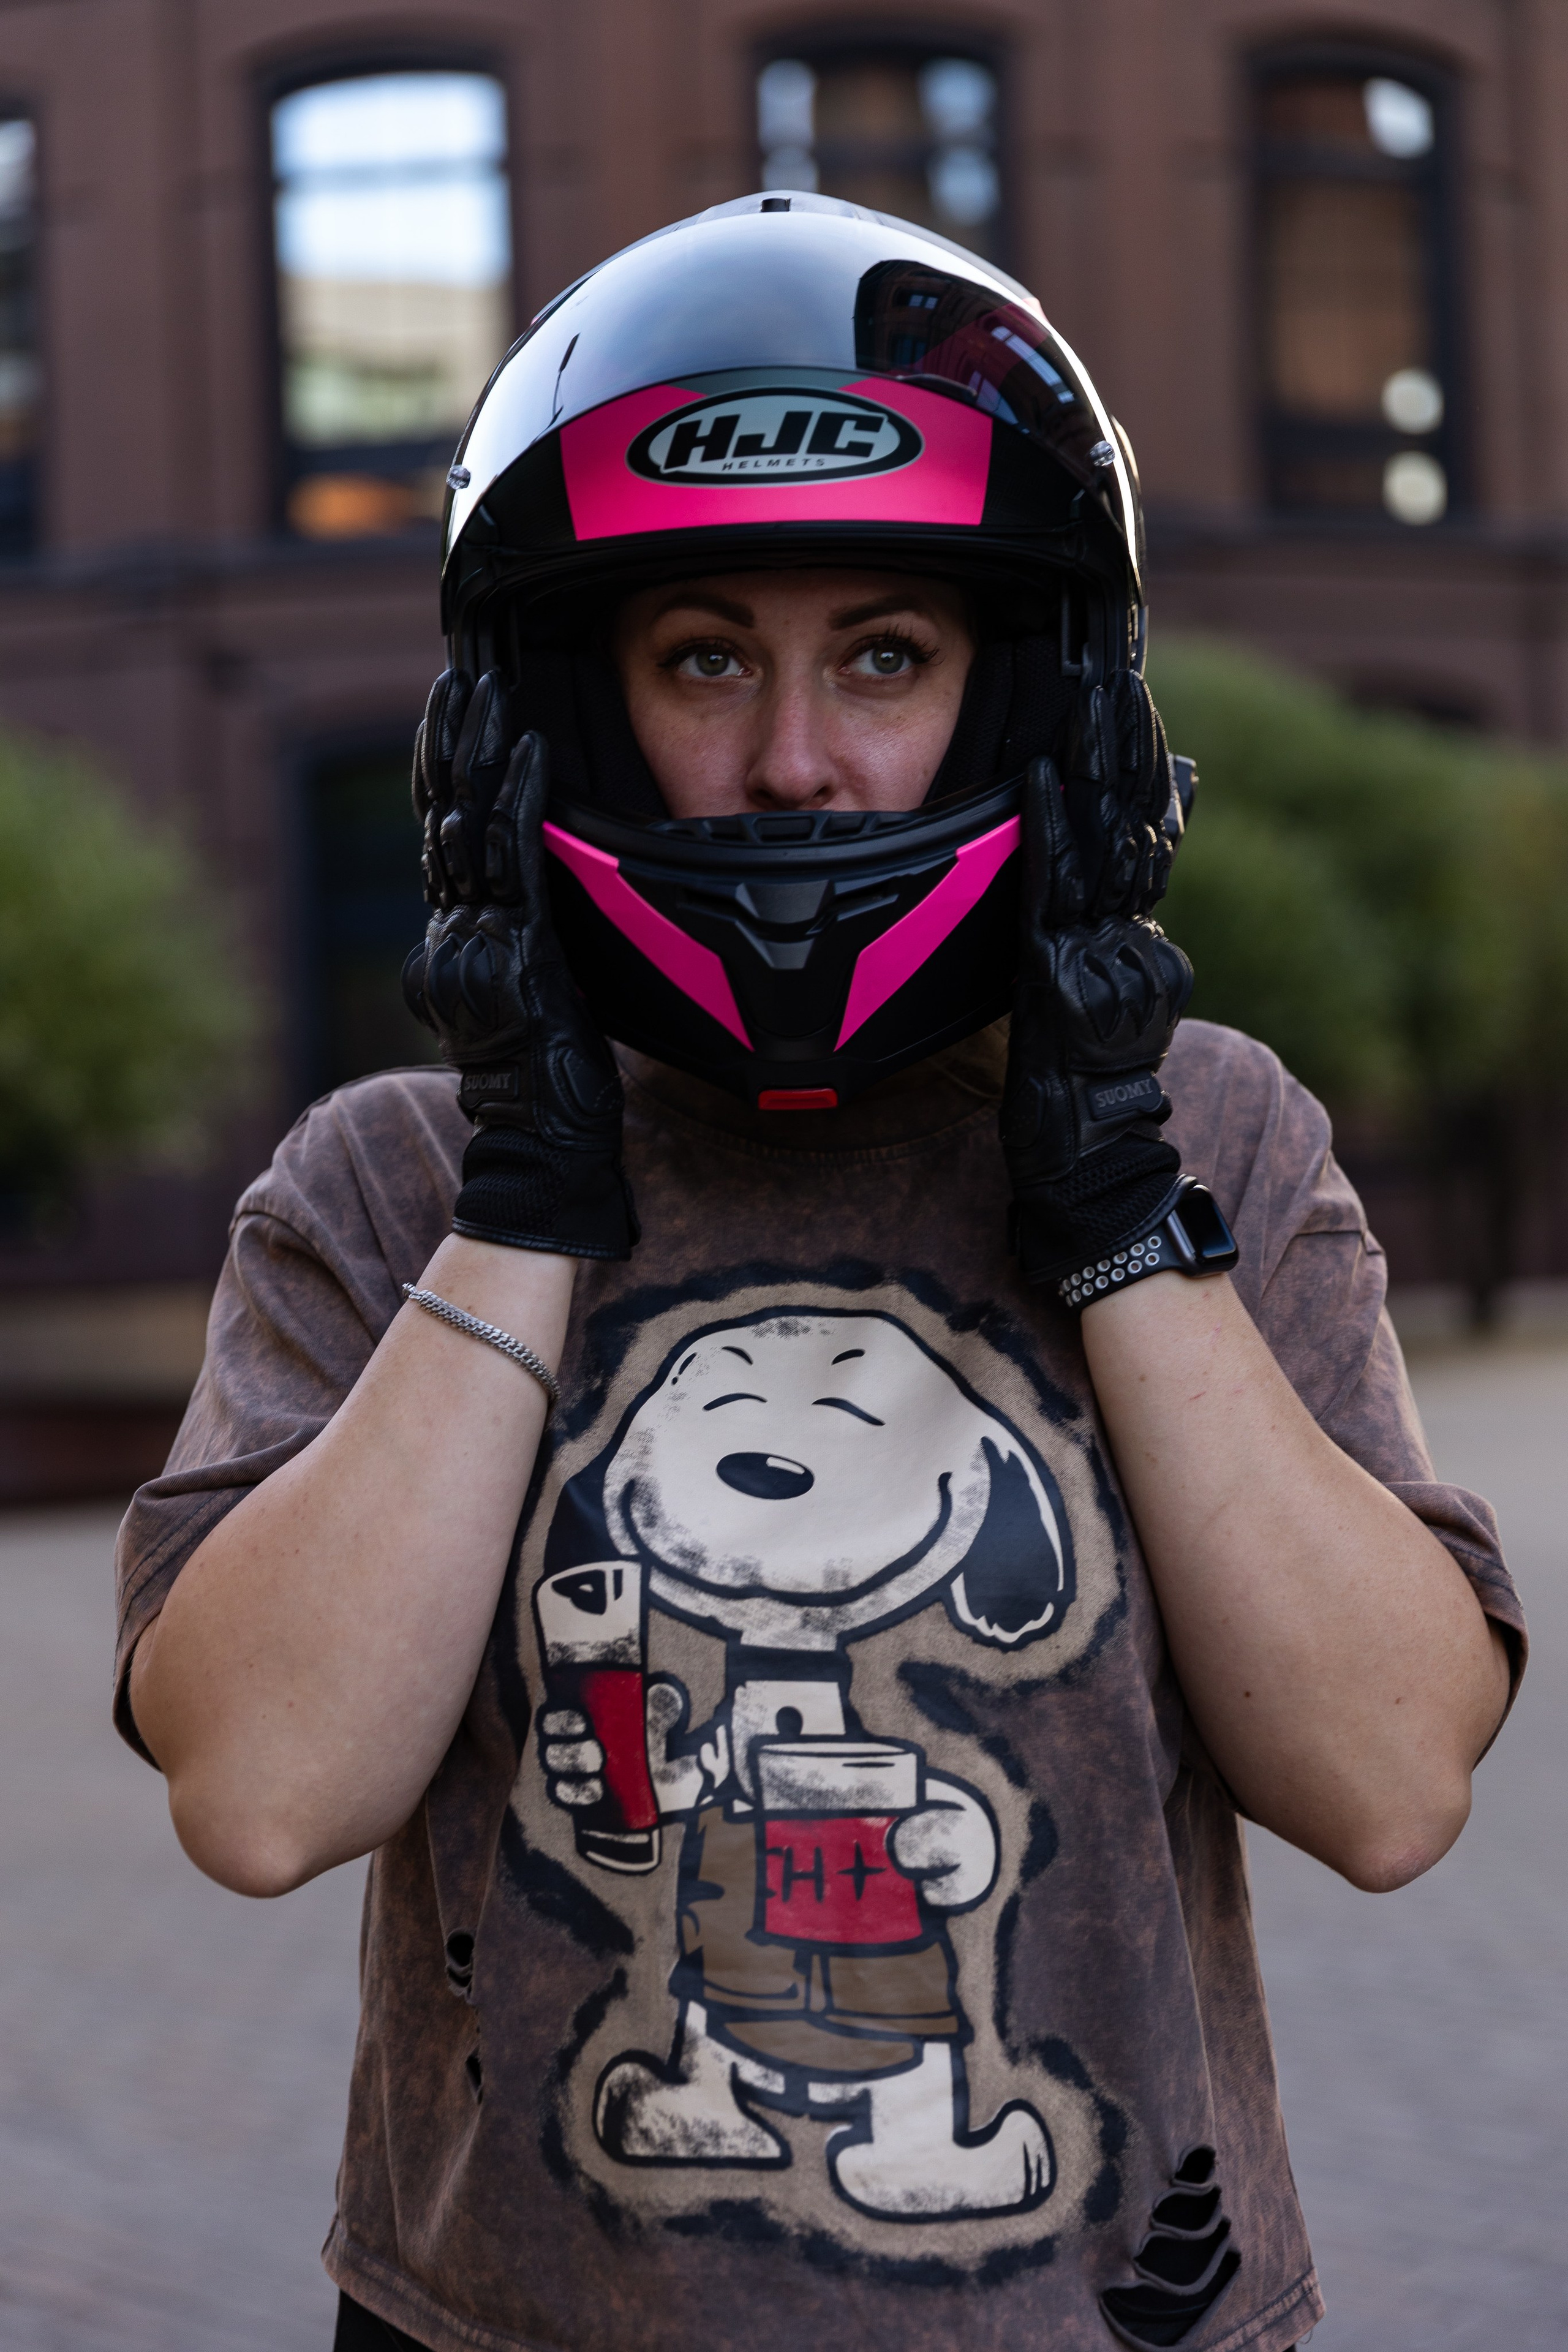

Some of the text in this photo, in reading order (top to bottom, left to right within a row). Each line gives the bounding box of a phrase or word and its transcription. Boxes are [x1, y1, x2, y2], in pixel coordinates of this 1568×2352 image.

[663, 410, 888, 470] HJC
[722, 458, 824, 471] HELMETS
[464, 1072, 512, 1091] SUOMY
[1095, 1078, 1153, 1108] SUOMY
